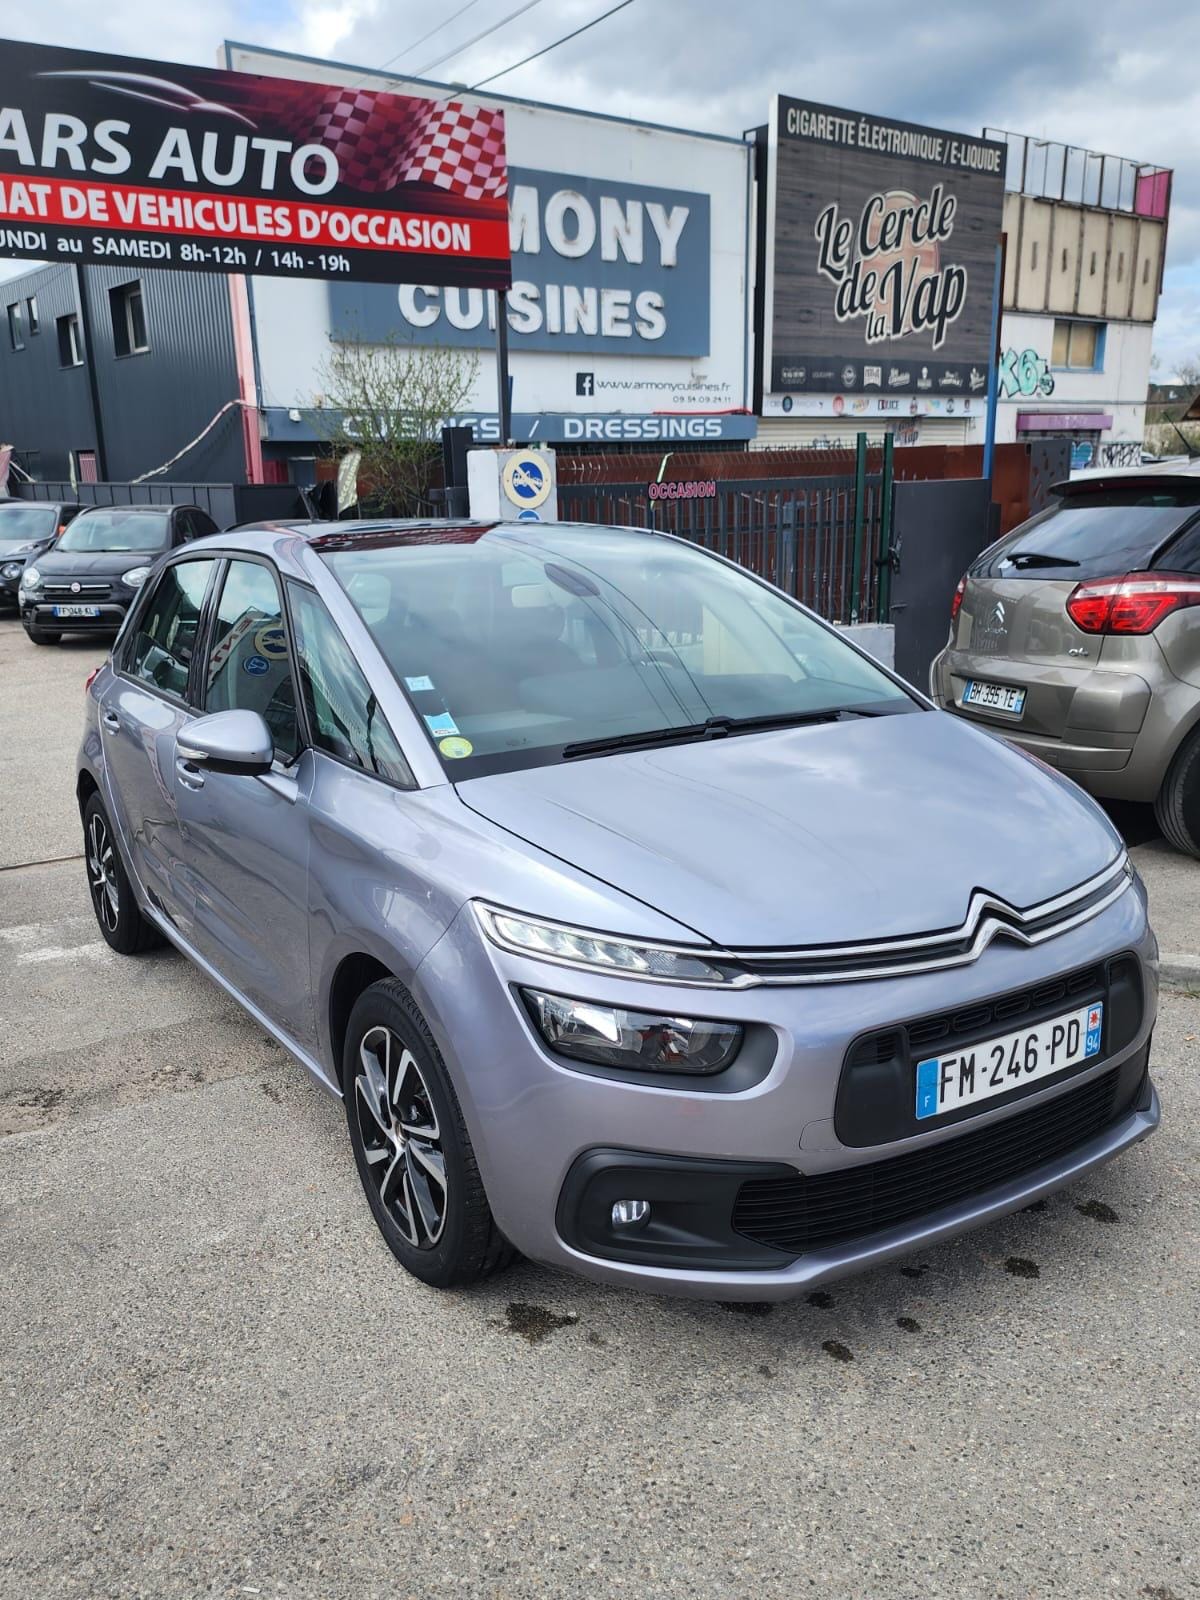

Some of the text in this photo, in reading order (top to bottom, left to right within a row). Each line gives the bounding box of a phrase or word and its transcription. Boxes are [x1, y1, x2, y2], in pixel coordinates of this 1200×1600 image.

[0, 107, 339, 196] ARS AUTO
[787, 108, 855, 144] CIGARETTE
[858, 117, 942, 162] ÉLECTRONIQUE
[943, 141, 950, 164] /
[60, 186, 109, 222] DE
[112, 190, 293, 238] VEHICULES
[300, 211, 471, 252] D'OCCASION
[815, 183, 957, 282] Le Cercle
[57, 238, 83, 253] au
[92, 236, 171, 260] SAMEDI
[180, 243, 247, 267] 8h-12h
[255, 249, 262, 267] /
[271, 250, 304, 269] 14h
[319, 254, 350, 273] 19h
[399, 281, 667, 340] CUISINES
[835, 254, 968, 350] de la Vap
[597, 379, 731, 393] www.armonycuisines.fr
[564, 418, 722, 439] DRESSINGS
[649, 481, 716, 499] OCCASION
[940, 1018, 1080, 1104] FM-246-PD
[1086, 1034, 1100, 1053] 94
[924, 1095, 931, 1109] F
